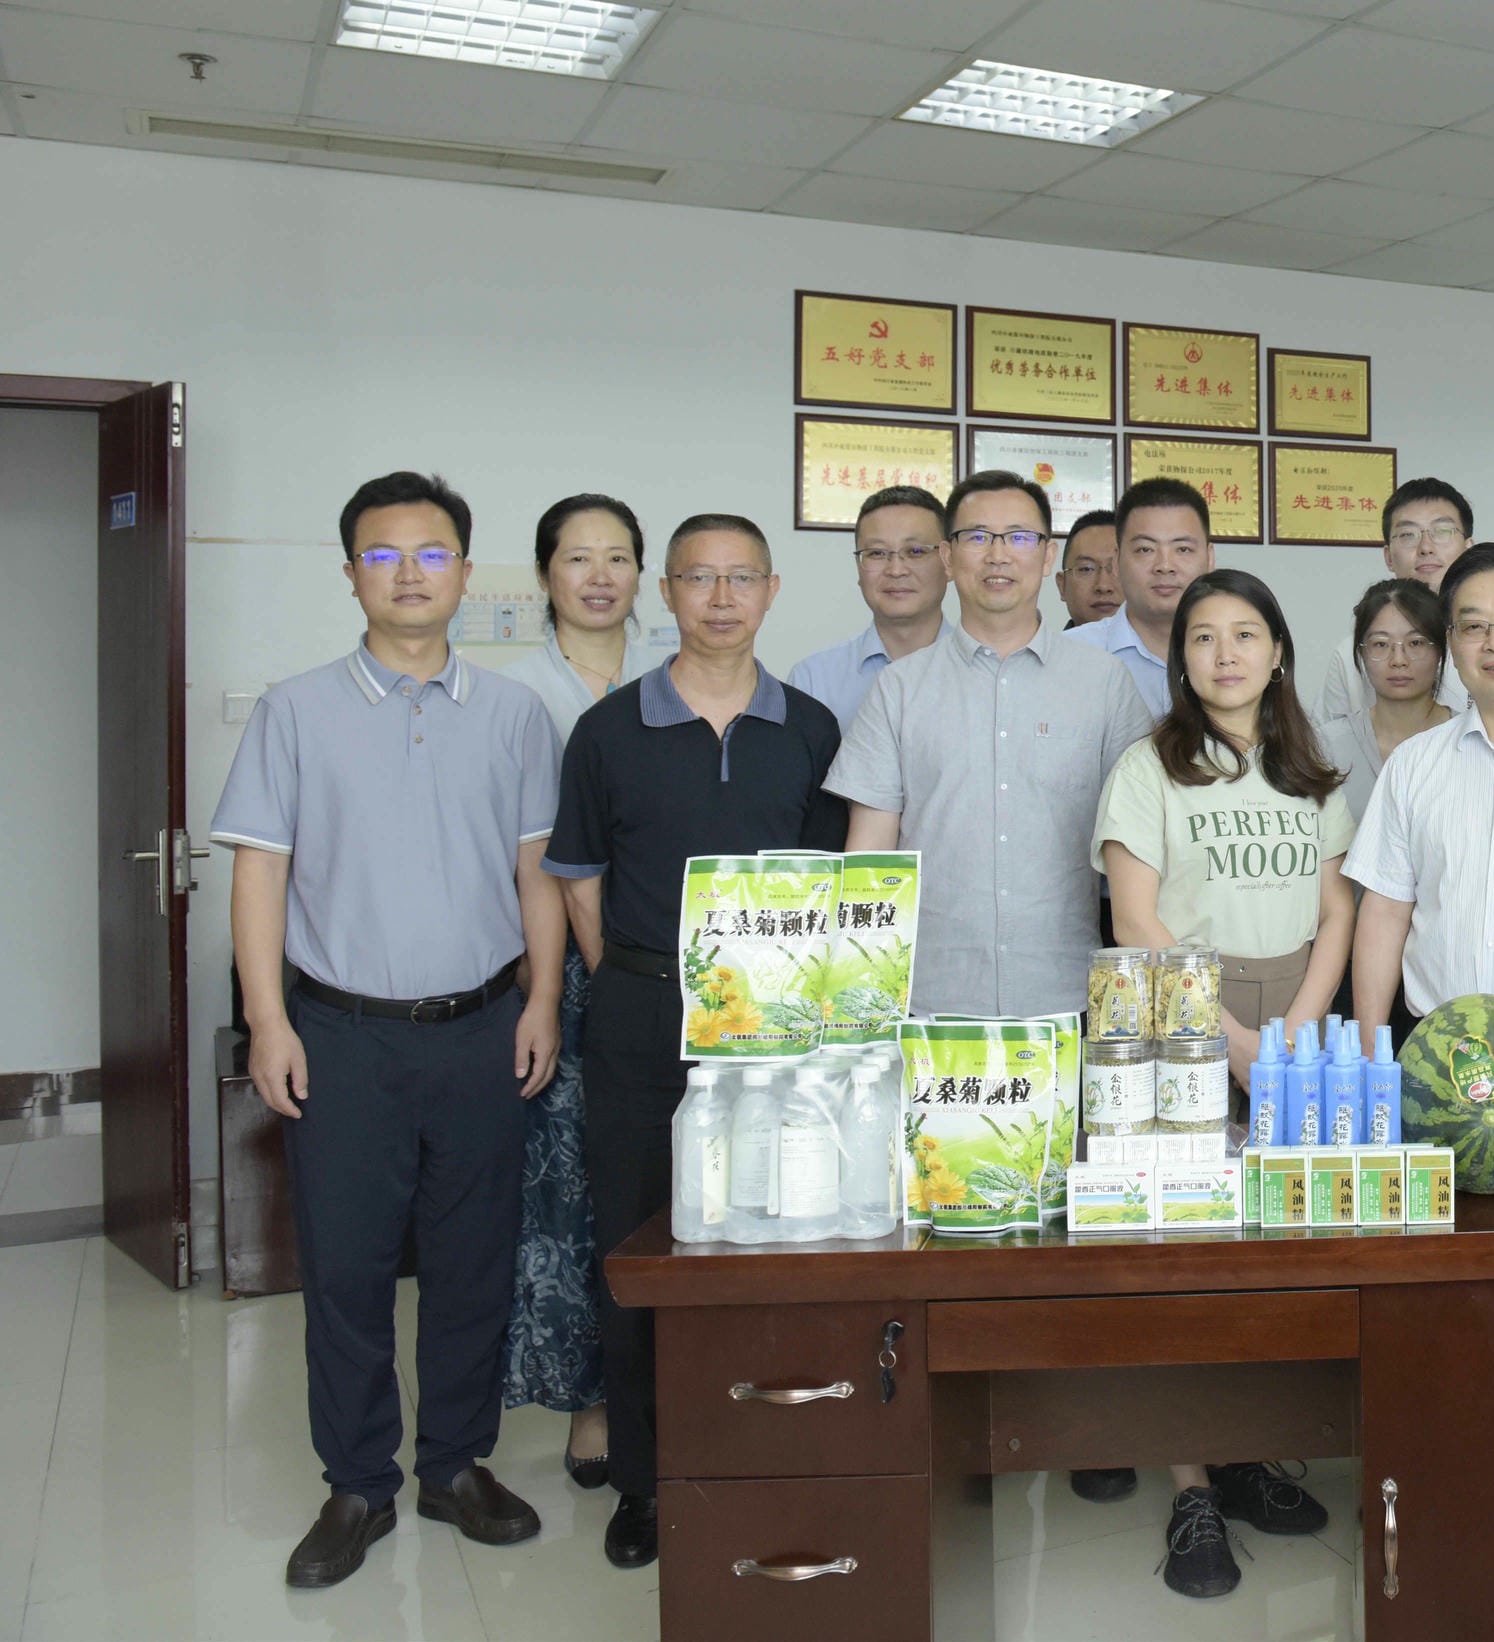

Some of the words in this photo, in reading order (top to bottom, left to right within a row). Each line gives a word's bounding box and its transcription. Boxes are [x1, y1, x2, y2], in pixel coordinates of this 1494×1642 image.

[821, 346, 935, 371] 五好党支部
[990, 358, 1097, 382] 优秀劳务合作单位
[1154, 374, 1233, 397] 先进集体
[1288, 383, 1354, 403] 先进集体
[1047, 491, 1091, 504] 团支部
[1185, 480, 1242, 504] 集体
[1292, 494, 1378, 512] 先进集体
[1186, 810, 1322, 842] PERFECT
[1204, 842, 1318, 881] MOOD
[703, 909, 829, 937] 夏桑菊颗粒
[912, 1077, 1032, 1105] 夏桑菊颗粒
[1110, 1073, 1122, 1106] 金银花
[1187, 1071, 1199, 1104] 金银花
[1338, 1106, 1348, 1145] 驱蚊花露
[1291, 1178, 1304, 1221] 风油精
[1340, 1177, 1352, 1220] 风油精
[1388, 1176, 1400, 1219] 风油精
[1437, 1175, 1450, 1219] 风油精
